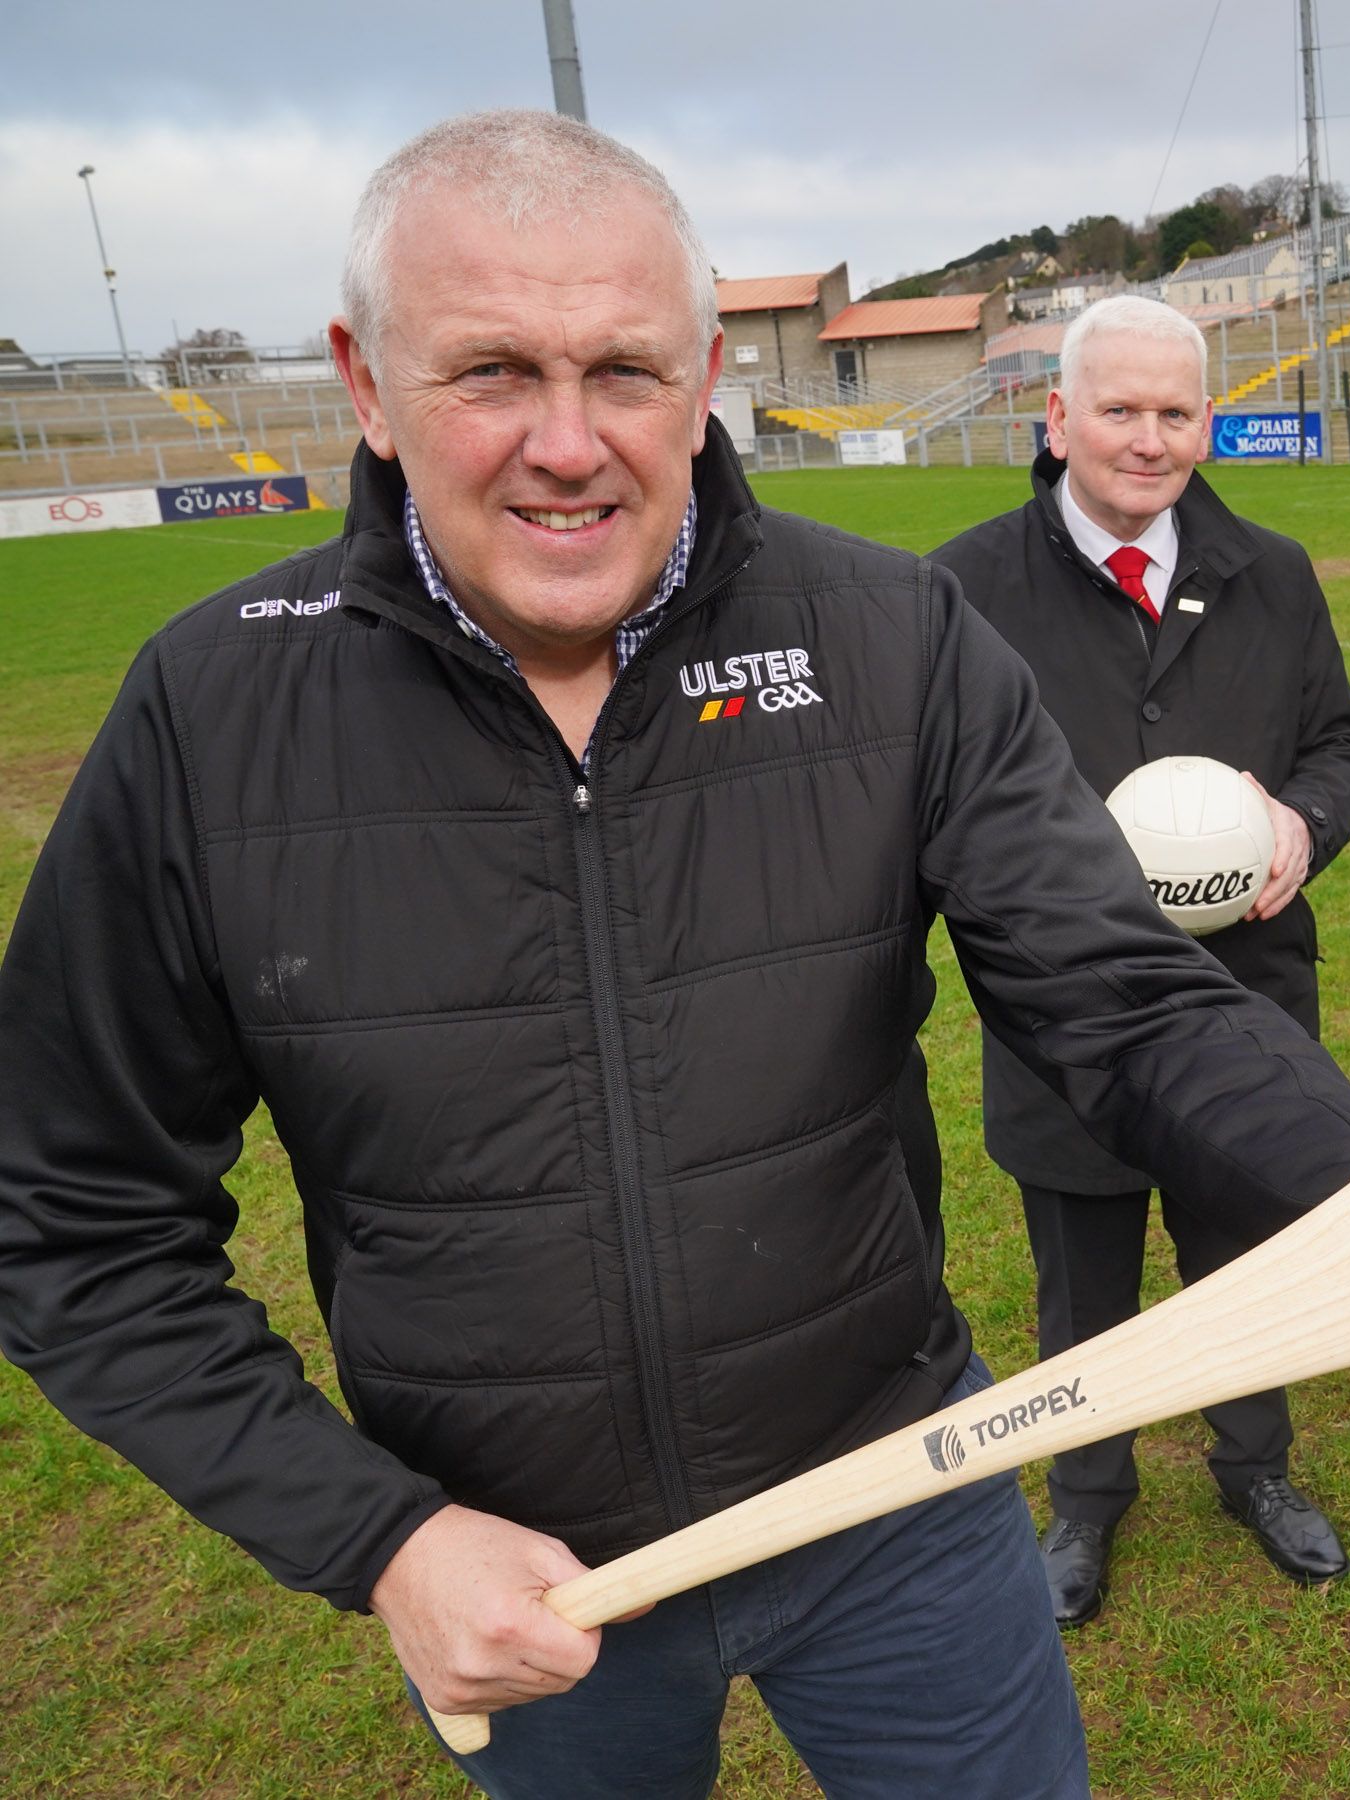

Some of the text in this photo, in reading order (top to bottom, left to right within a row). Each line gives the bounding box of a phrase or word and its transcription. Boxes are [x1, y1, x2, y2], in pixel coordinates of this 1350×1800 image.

[48, 496, 103, 522] EOS
[175, 489, 257, 514] QUAYS
[679, 648, 815, 697] ULSTER
[758, 681, 824, 713] GAA
[969, 1376, 1087, 1448] TORPEY
